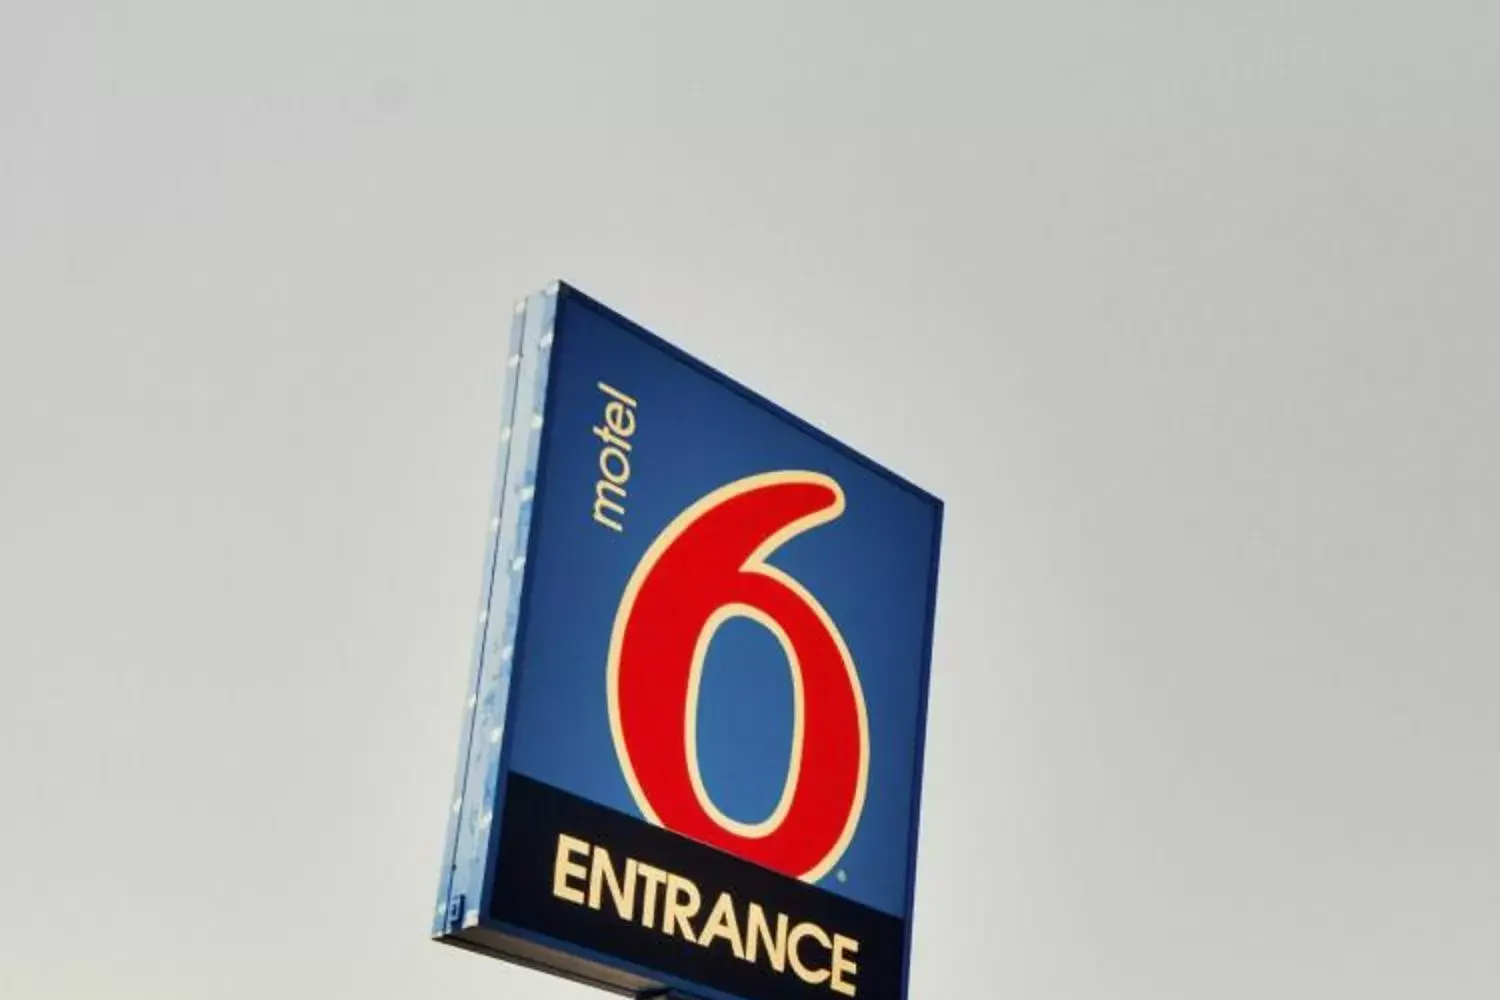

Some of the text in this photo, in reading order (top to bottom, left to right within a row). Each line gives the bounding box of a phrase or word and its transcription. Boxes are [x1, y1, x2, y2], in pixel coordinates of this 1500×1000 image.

[592, 380, 638, 532] motel
[605, 469, 871, 885] 6
[553, 833, 860, 998] ENTRANCE
